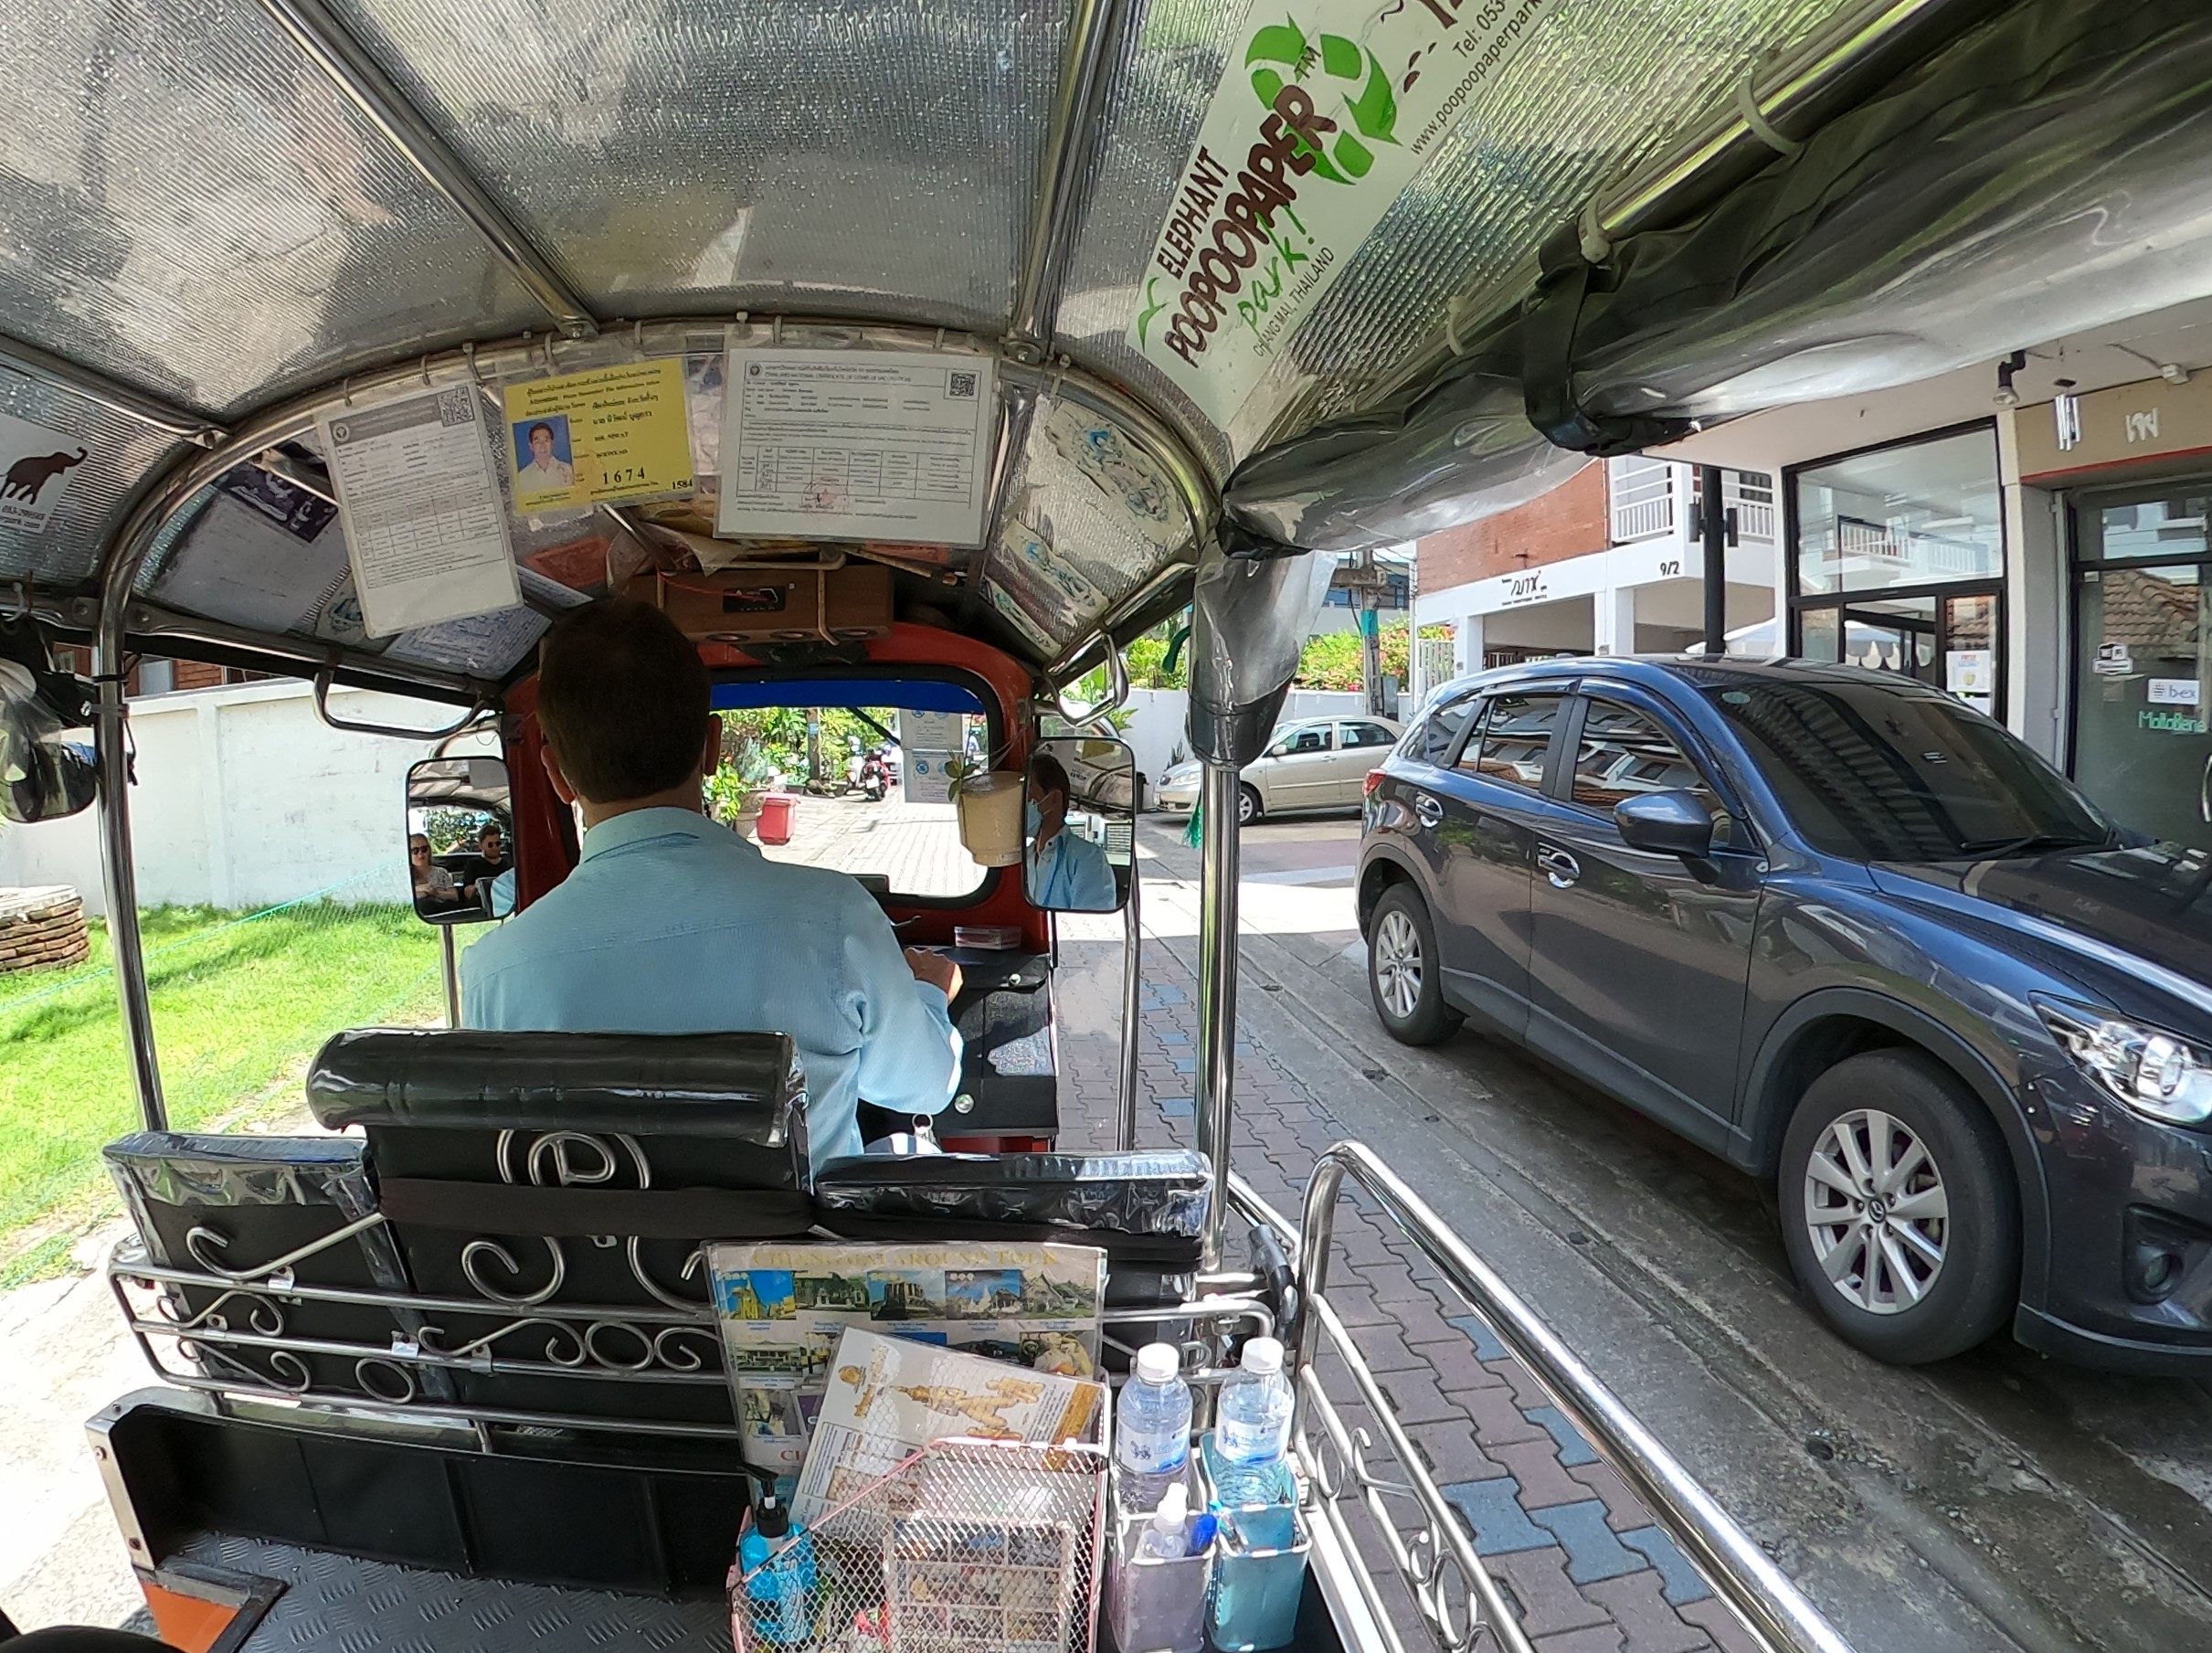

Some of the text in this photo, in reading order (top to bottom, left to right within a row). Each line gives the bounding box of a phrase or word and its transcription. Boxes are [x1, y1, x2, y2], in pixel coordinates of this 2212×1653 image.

[1452, 29, 1483, 58] Tel:
[1157, 145, 1229, 280] ELEPHANT
[1165, 46, 1338, 369] POOPOOPAPER TM
[1288, 246, 1335, 304] THAILAND
[603, 467, 645, 485] 1674
[1660, 560, 1680, 577] 9/2
